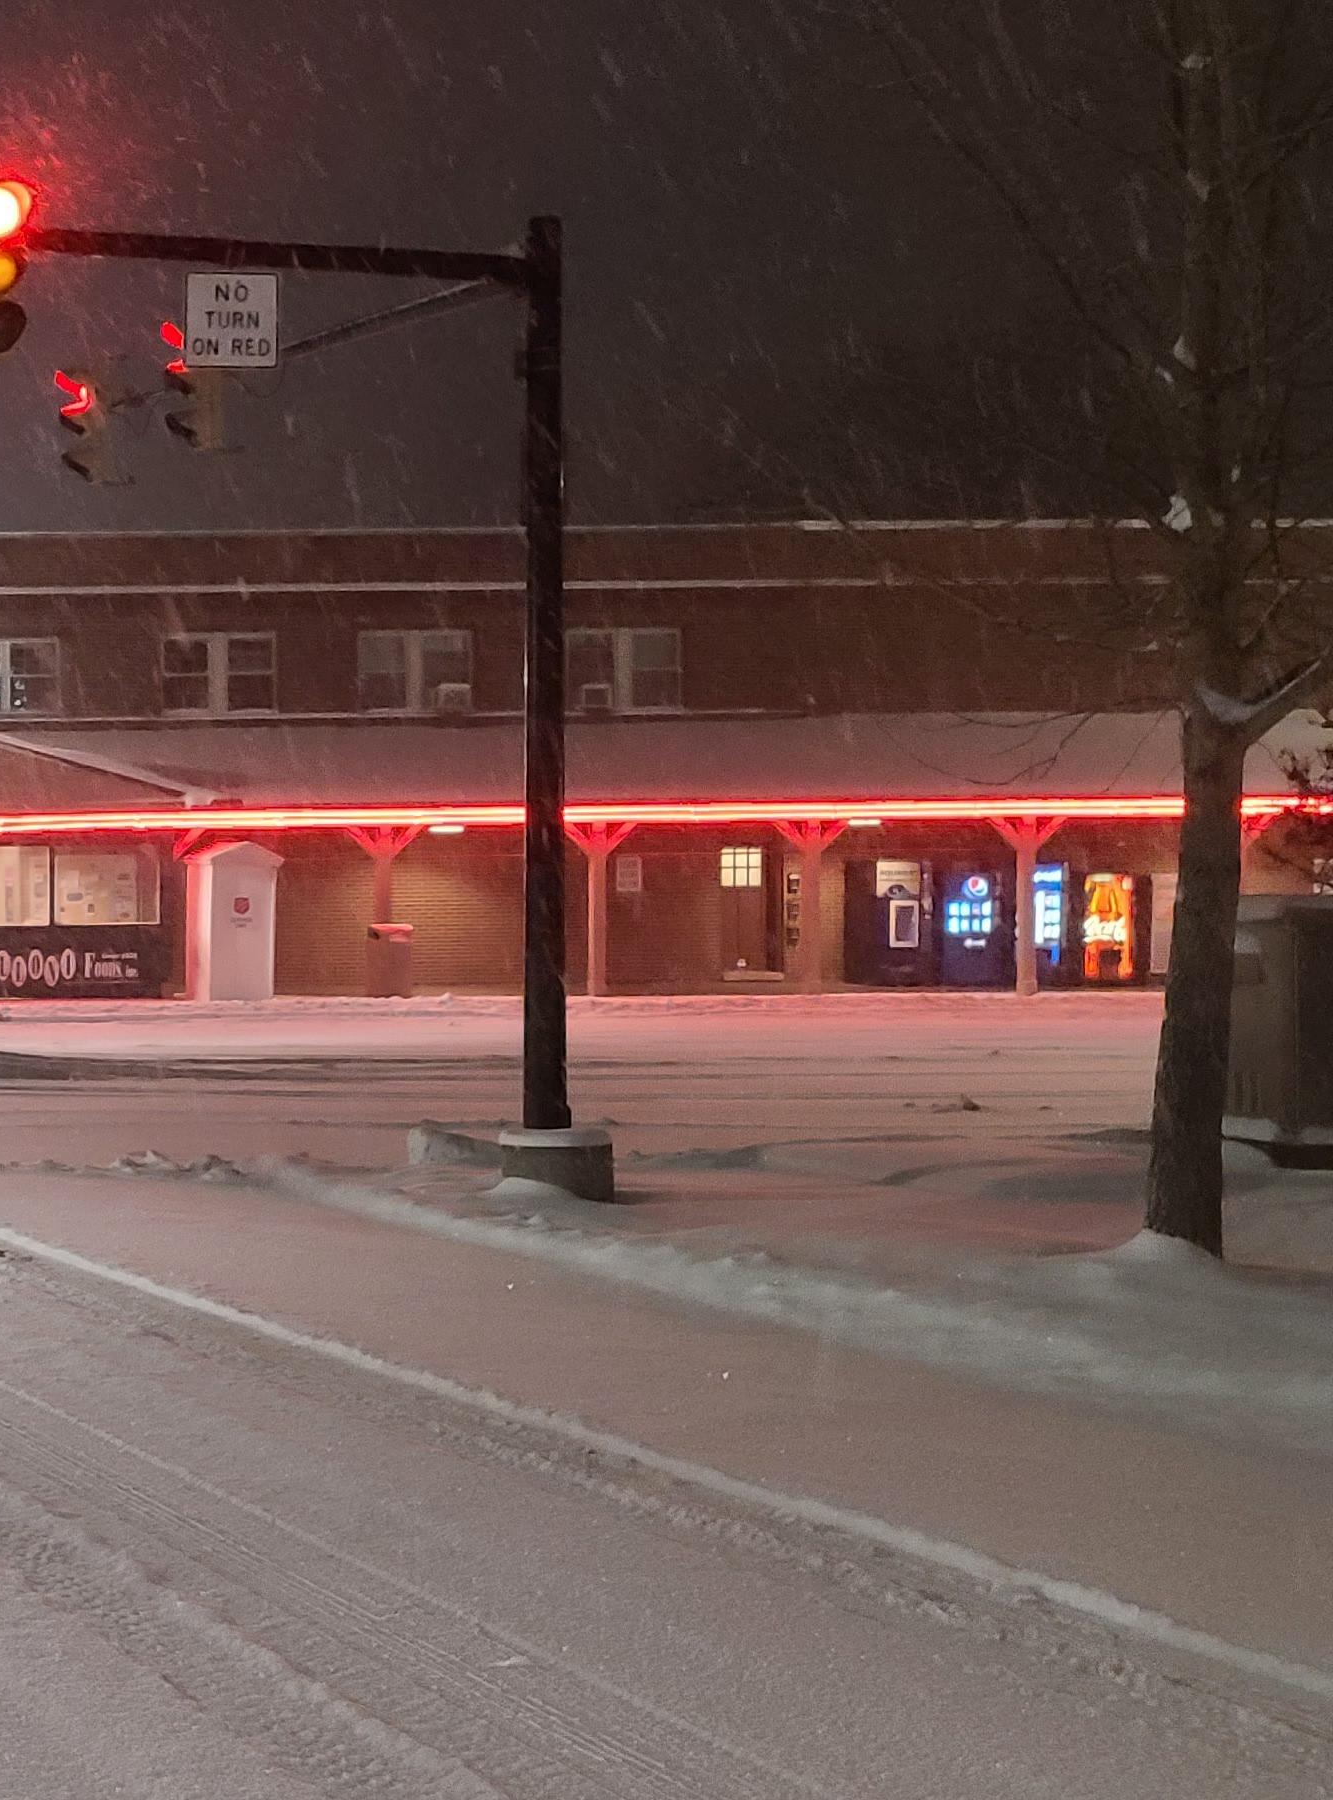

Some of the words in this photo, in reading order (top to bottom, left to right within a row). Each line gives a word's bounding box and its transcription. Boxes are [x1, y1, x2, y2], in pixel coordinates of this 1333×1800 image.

[214, 283, 249, 302] NO
[205, 311, 259, 328] TURN
[192, 338, 219, 355] ON
[232, 338, 271, 356] RED
